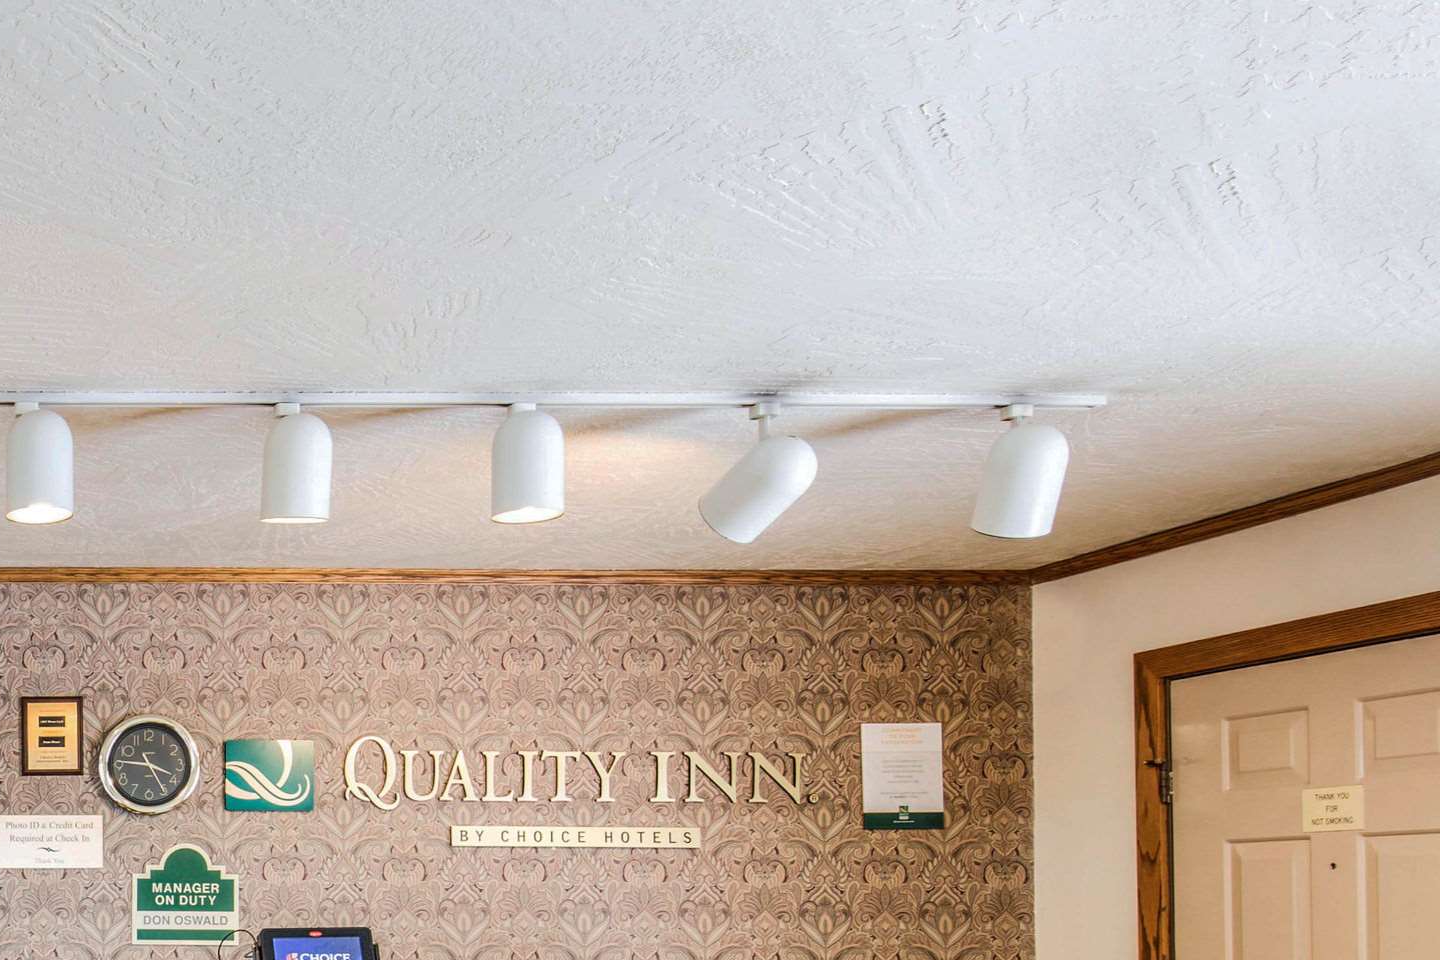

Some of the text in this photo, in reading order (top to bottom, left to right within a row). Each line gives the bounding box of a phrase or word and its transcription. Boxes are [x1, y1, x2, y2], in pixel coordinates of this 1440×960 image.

[144, 729, 154, 741] 12
[121, 745, 135, 757] 10
[169, 744, 178, 756] 2
[176, 759, 184, 772] 3
[344, 735, 809, 810] QUALITY INN
[119, 773, 128, 786] 8
[169, 774, 177, 785] 4
[131, 784, 139, 796] 7
[144, 788, 154, 800] 6
[1314, 792, 1350, 800] THANK YOU
[1325, 805, 1338, 813] FOR
[1325, 816, 1354, 825] SMOKING
[9, 834, 43, 844] Required
[54, 834, 79, 842] Check
[460, 830, 692, 844] BY CHOICE HOTELS
[152, 883, 219, 894] MANAGER
[155, 895, 216, 906] ON DUTY
[143, 915, 228, 926] DON OSWALD
